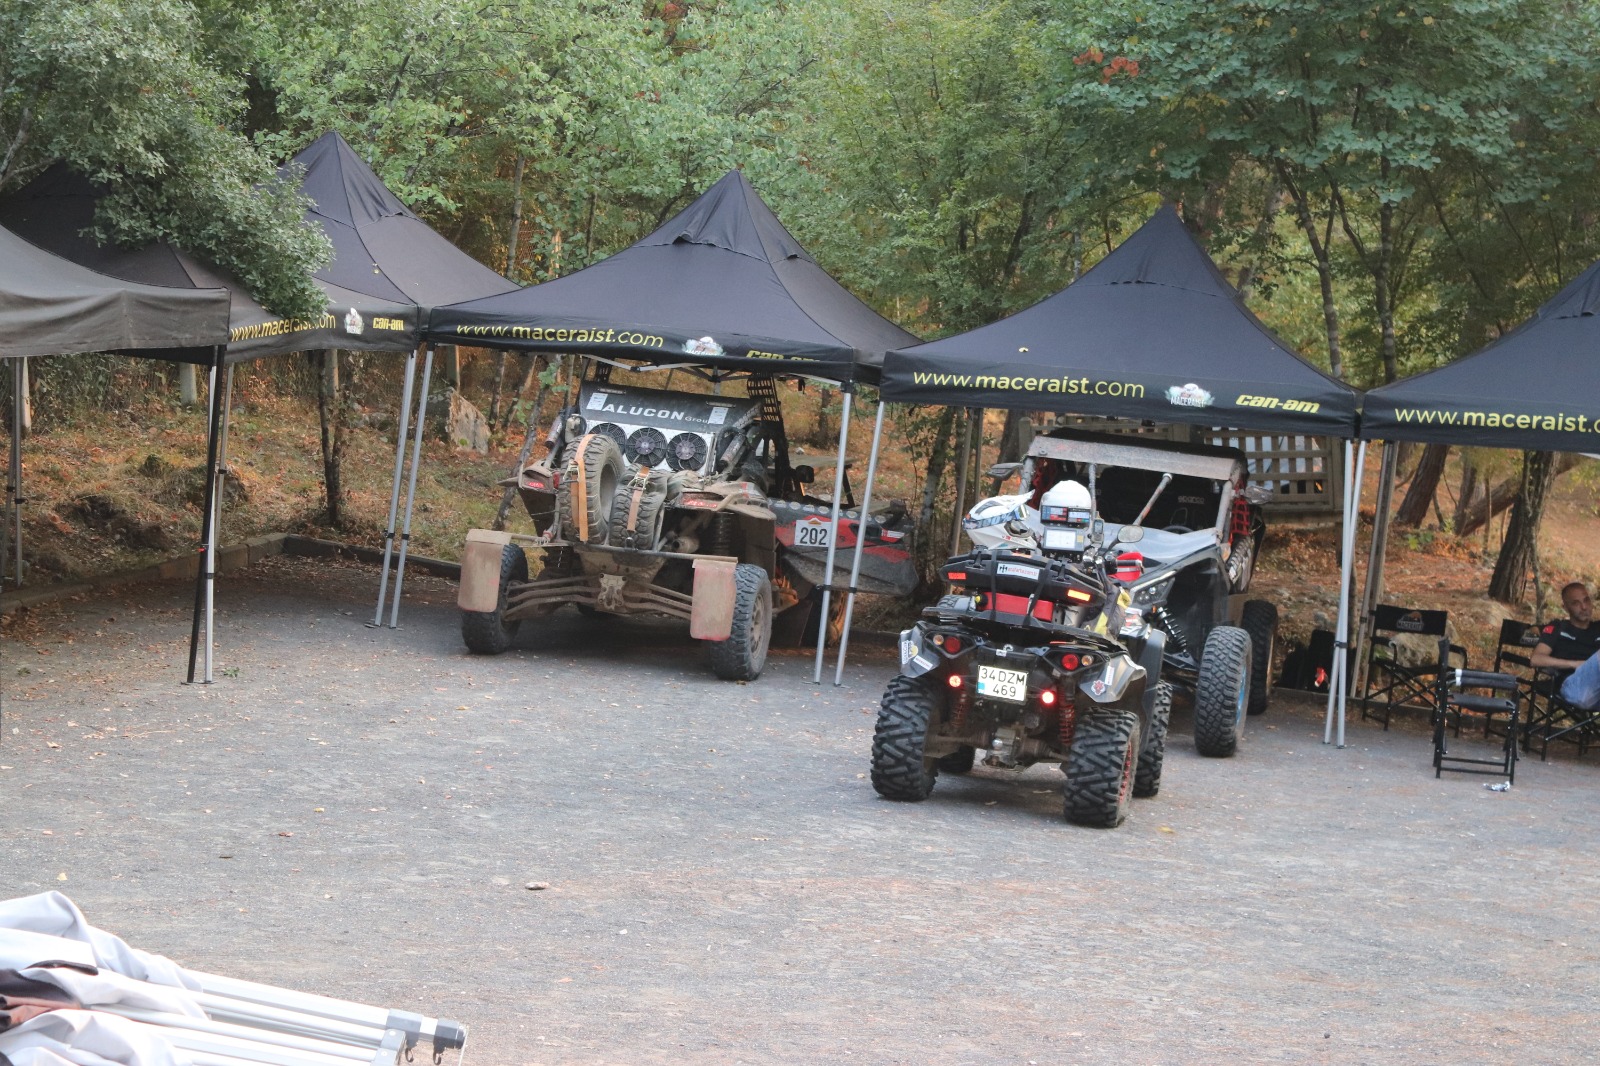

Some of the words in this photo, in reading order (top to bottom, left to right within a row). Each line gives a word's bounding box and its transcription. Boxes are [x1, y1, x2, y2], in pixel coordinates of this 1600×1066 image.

[372, 317, 405, 331] can-am
[456, 324, 664, 348] www.maceraist.com
[913, 371, 1145, 399] www.maceraist.com
[602, 403, 685, 421] ALUCON
[684, 415, 710, 425] Grou
[1236, 394, 1320, 414] can-am
[799, 526, 828, 546] 202
[992, 683, 1017, 698] 469
